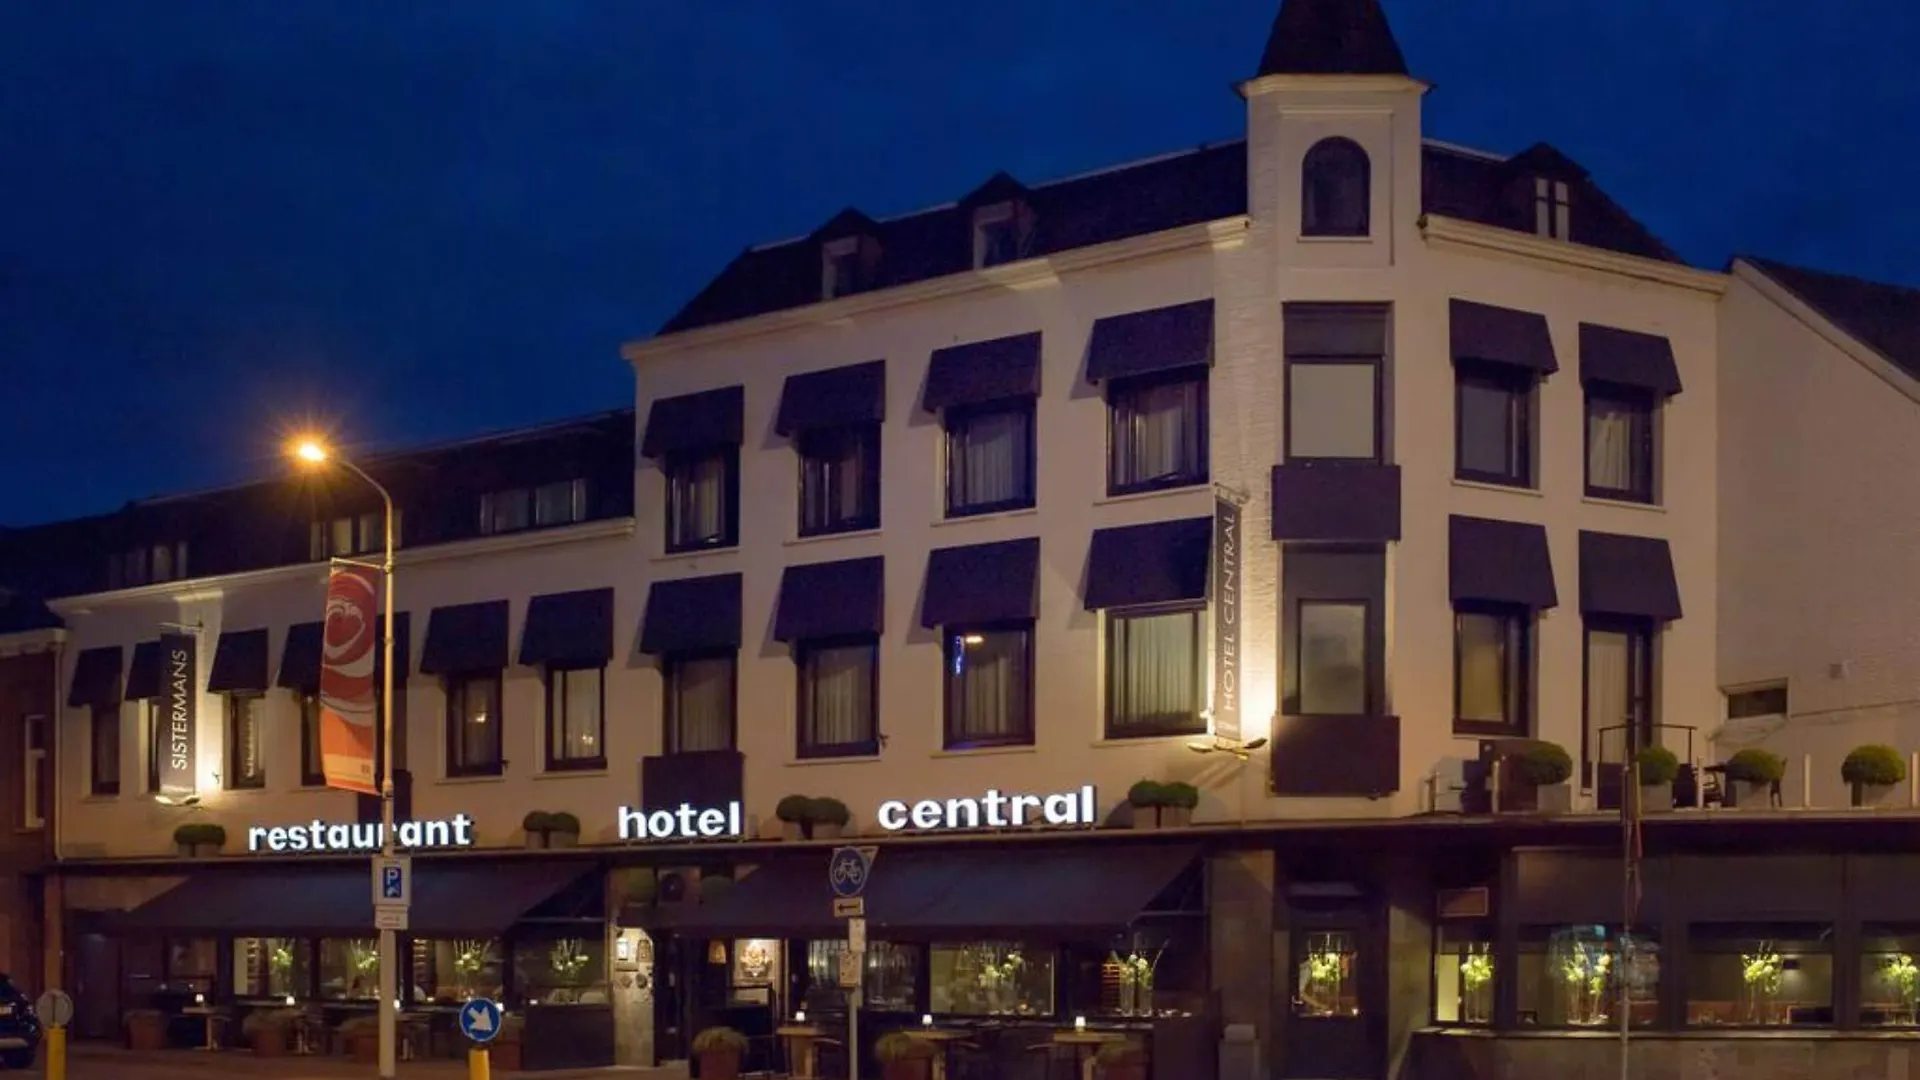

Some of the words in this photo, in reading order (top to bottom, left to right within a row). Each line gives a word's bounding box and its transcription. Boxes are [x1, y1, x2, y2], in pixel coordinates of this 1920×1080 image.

[1223, 513, 1236, 625] CENTRAL
[172, 650, 187, 770] SISTERMANS
[1223, 633, 1236, 711] HOTEL
[618, 801, 741, 840] hotel
[877, 785, 1094, 831] central
